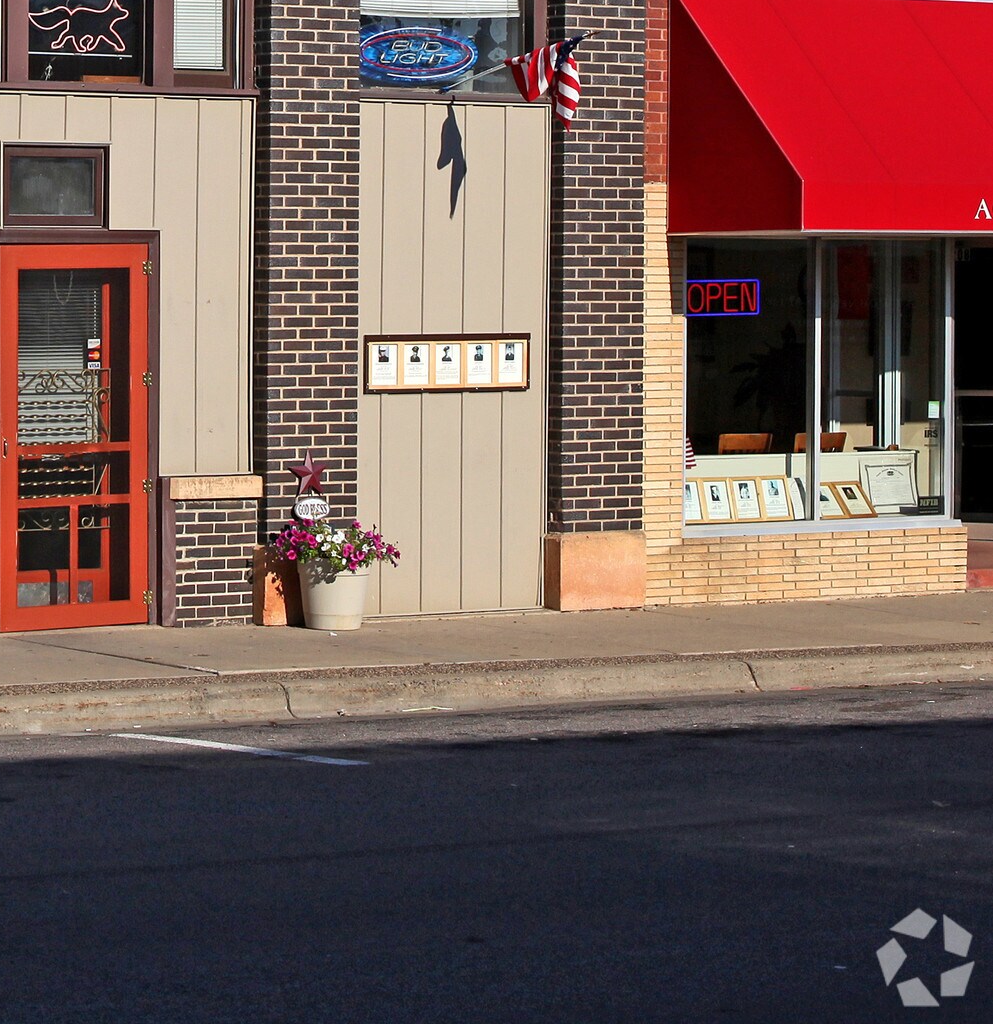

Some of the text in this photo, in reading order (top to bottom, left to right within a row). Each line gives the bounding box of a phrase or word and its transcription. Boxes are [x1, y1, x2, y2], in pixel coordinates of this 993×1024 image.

[391, 40, 443, 53] BUD
[380, 52, 448, 65] LIGHT
[974, 198, 993, 221] A
[688, 283, 757, 313] OPEN
[924, 429, 938, 439] IRS
